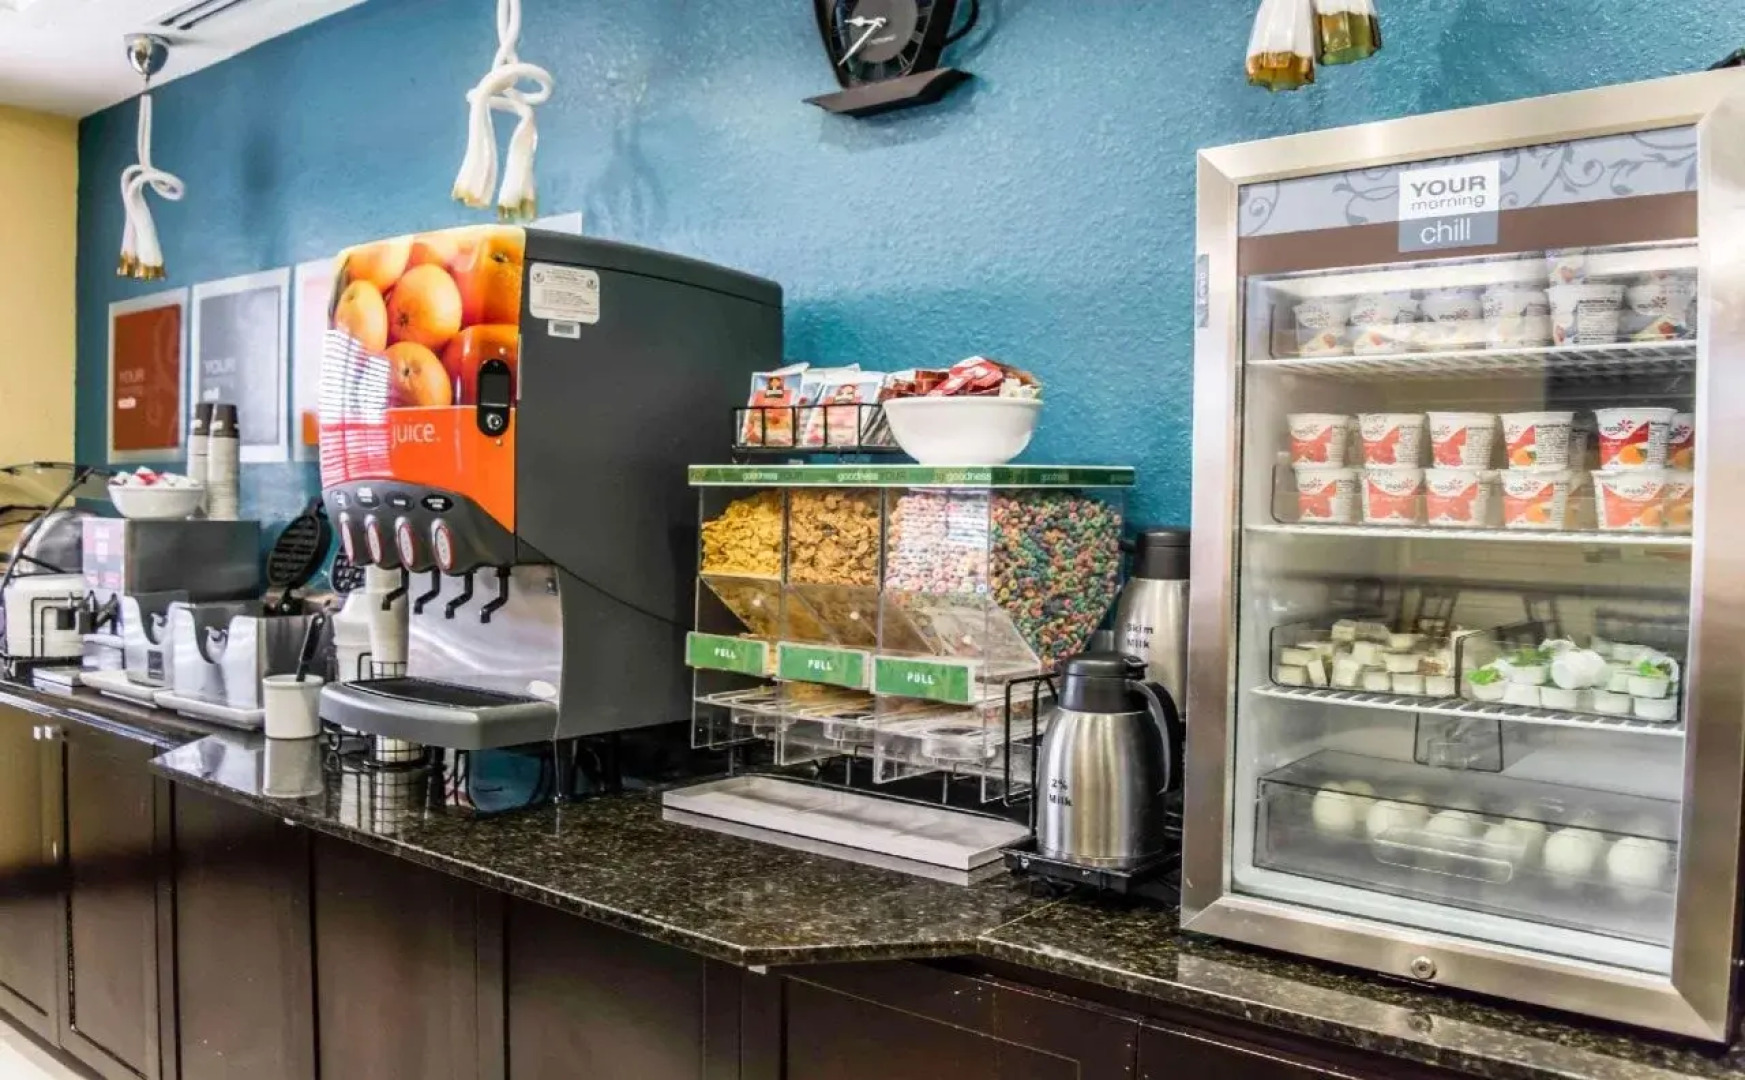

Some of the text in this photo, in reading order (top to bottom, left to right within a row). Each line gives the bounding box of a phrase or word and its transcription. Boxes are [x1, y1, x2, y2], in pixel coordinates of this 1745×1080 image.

[1410, 175, 1486, 198] YOUR
[1411, 195, 1485, 210] morning
[1421, 217, 1470, 244] chill
[945, 472, 992, 482] goodness
[1127, 638, 1150, 649] Milk
[714, 647, 737, 659] PULL
[808, 659, 833, 671] PULL
[907, 671, 935, 685] PULL
[1050, 794, 1073, 807] Milk
